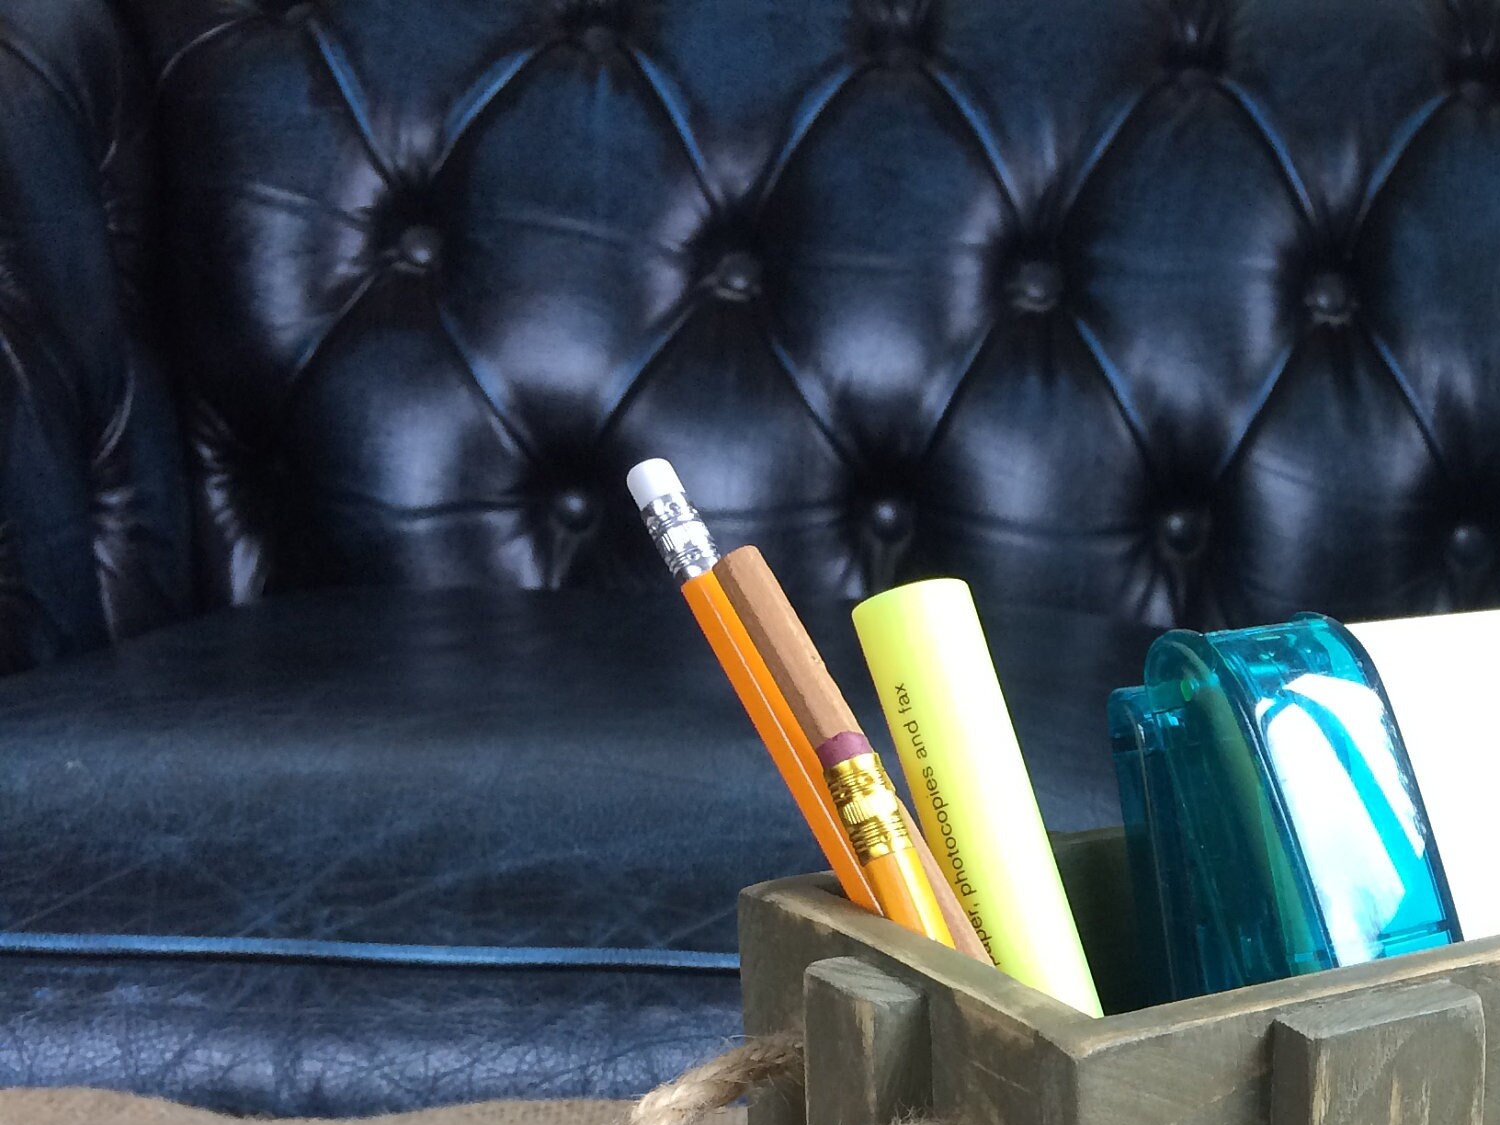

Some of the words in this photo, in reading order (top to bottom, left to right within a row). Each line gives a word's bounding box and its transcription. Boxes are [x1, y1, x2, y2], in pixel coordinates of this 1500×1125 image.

[895, 682, 912, 715] fax
[903, 719, 928, 760] and
[922, 765, 977, 898] photocopies
